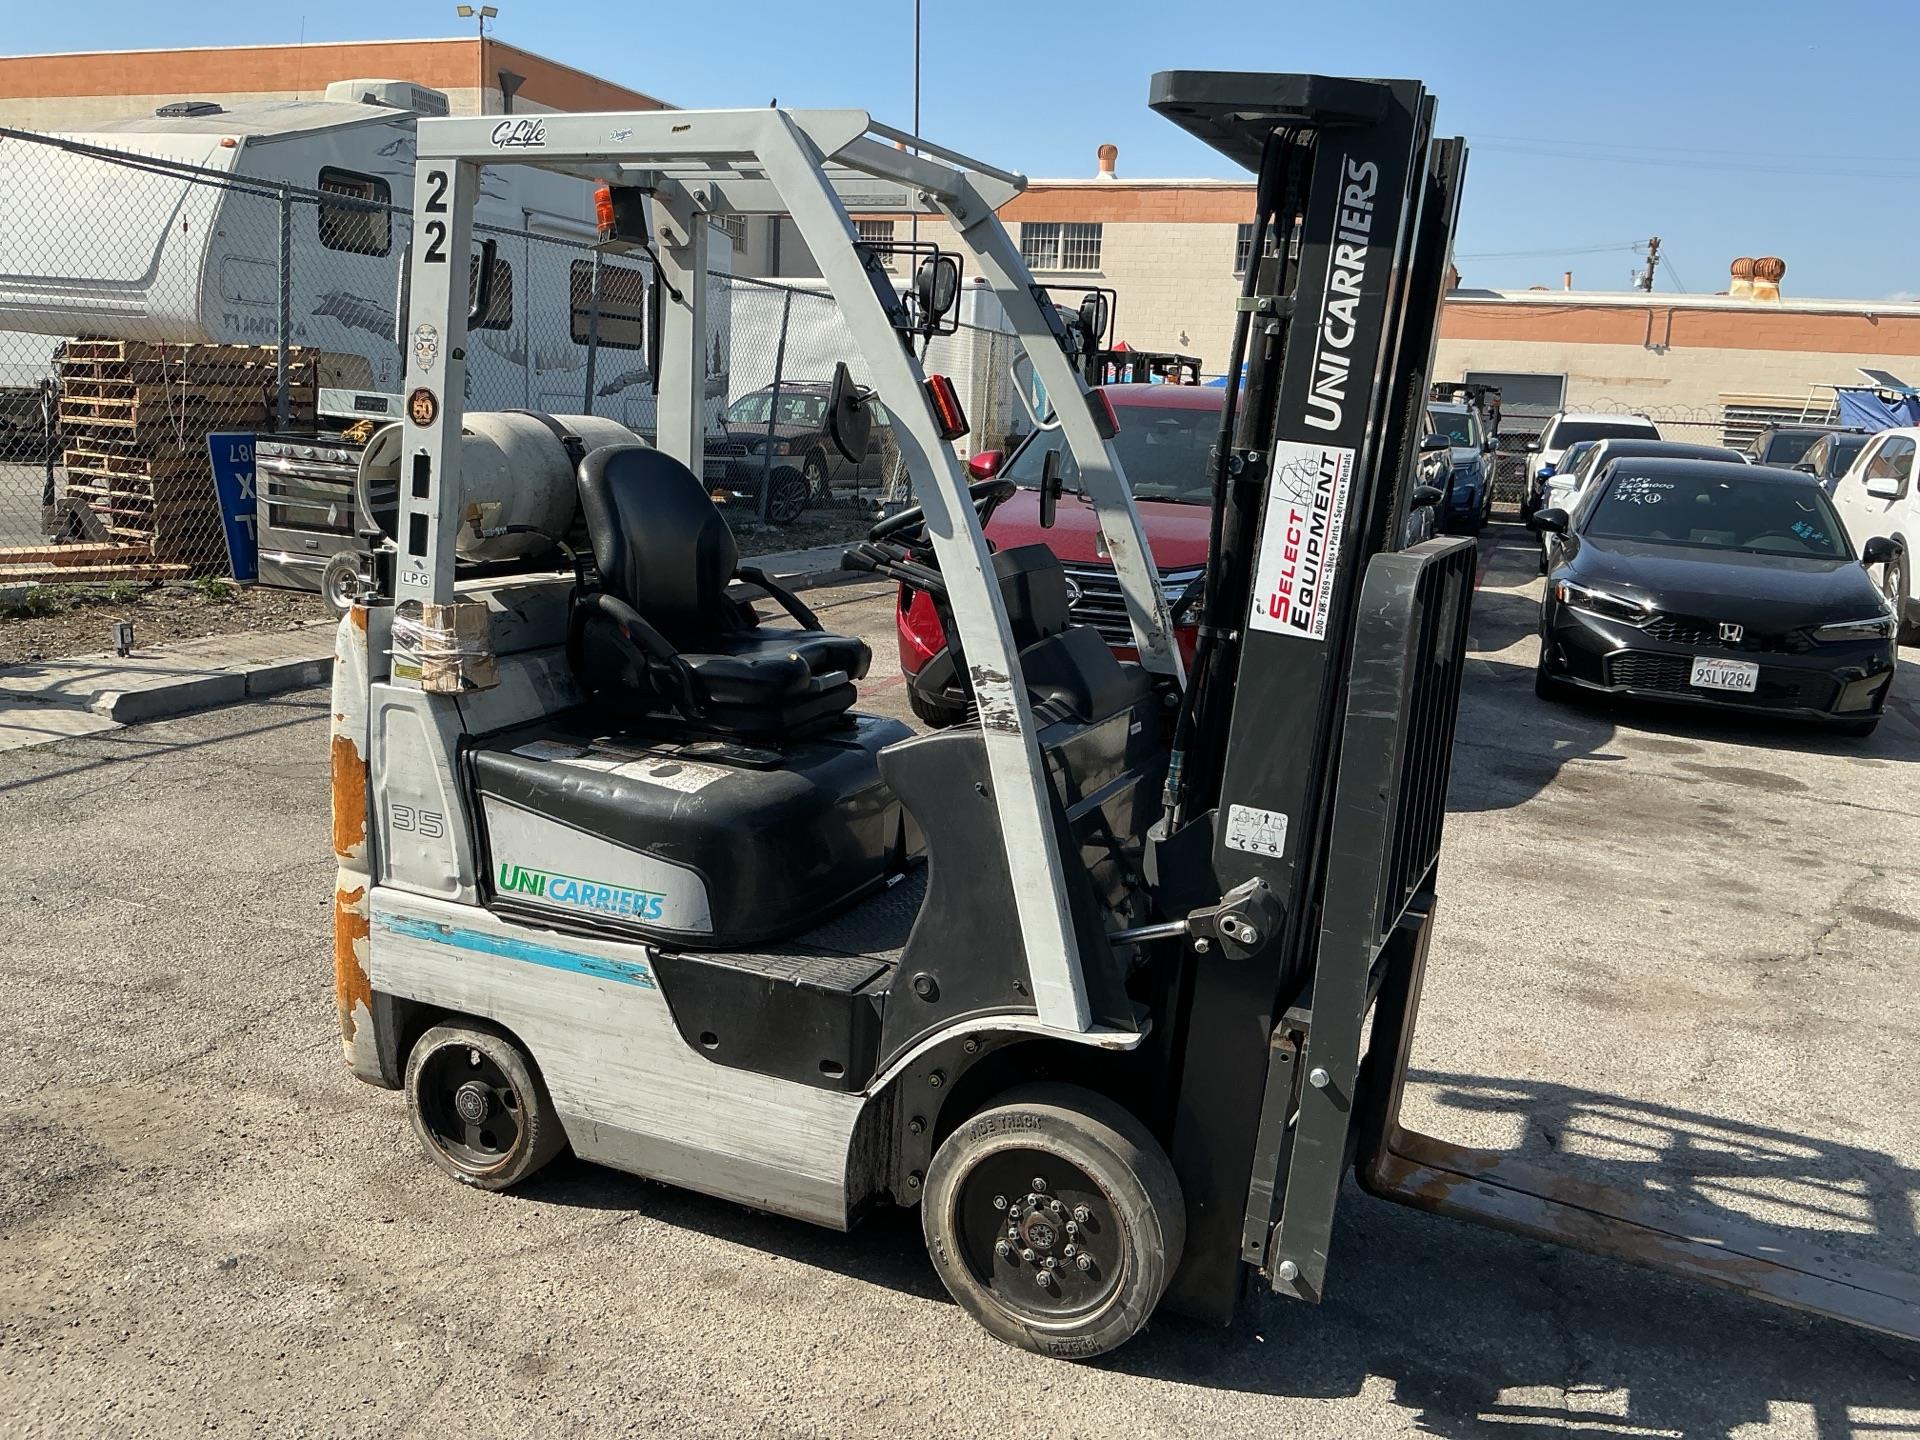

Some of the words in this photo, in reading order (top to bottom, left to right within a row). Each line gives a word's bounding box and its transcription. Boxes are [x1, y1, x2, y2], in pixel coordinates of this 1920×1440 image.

[222, 313, 307, 337] TUNDA
[1340, 453, 1352, 483] Rentals
[1334, 489, 1346, 518] Service
[1290, 451, 1336, 632] EQUIPMENT
[1330, 525, 1341, 546] Parts
[1269, 508, 1304, 623] SELECT
[1325, 552, 1336, 574] Sales
[403, 572, 430, 586] LPG
[1695, 668, 1751, 688] 9SLV284
[391, 804, 444, 839] 35
[998, 1114, 1042, 1130] TRACK
